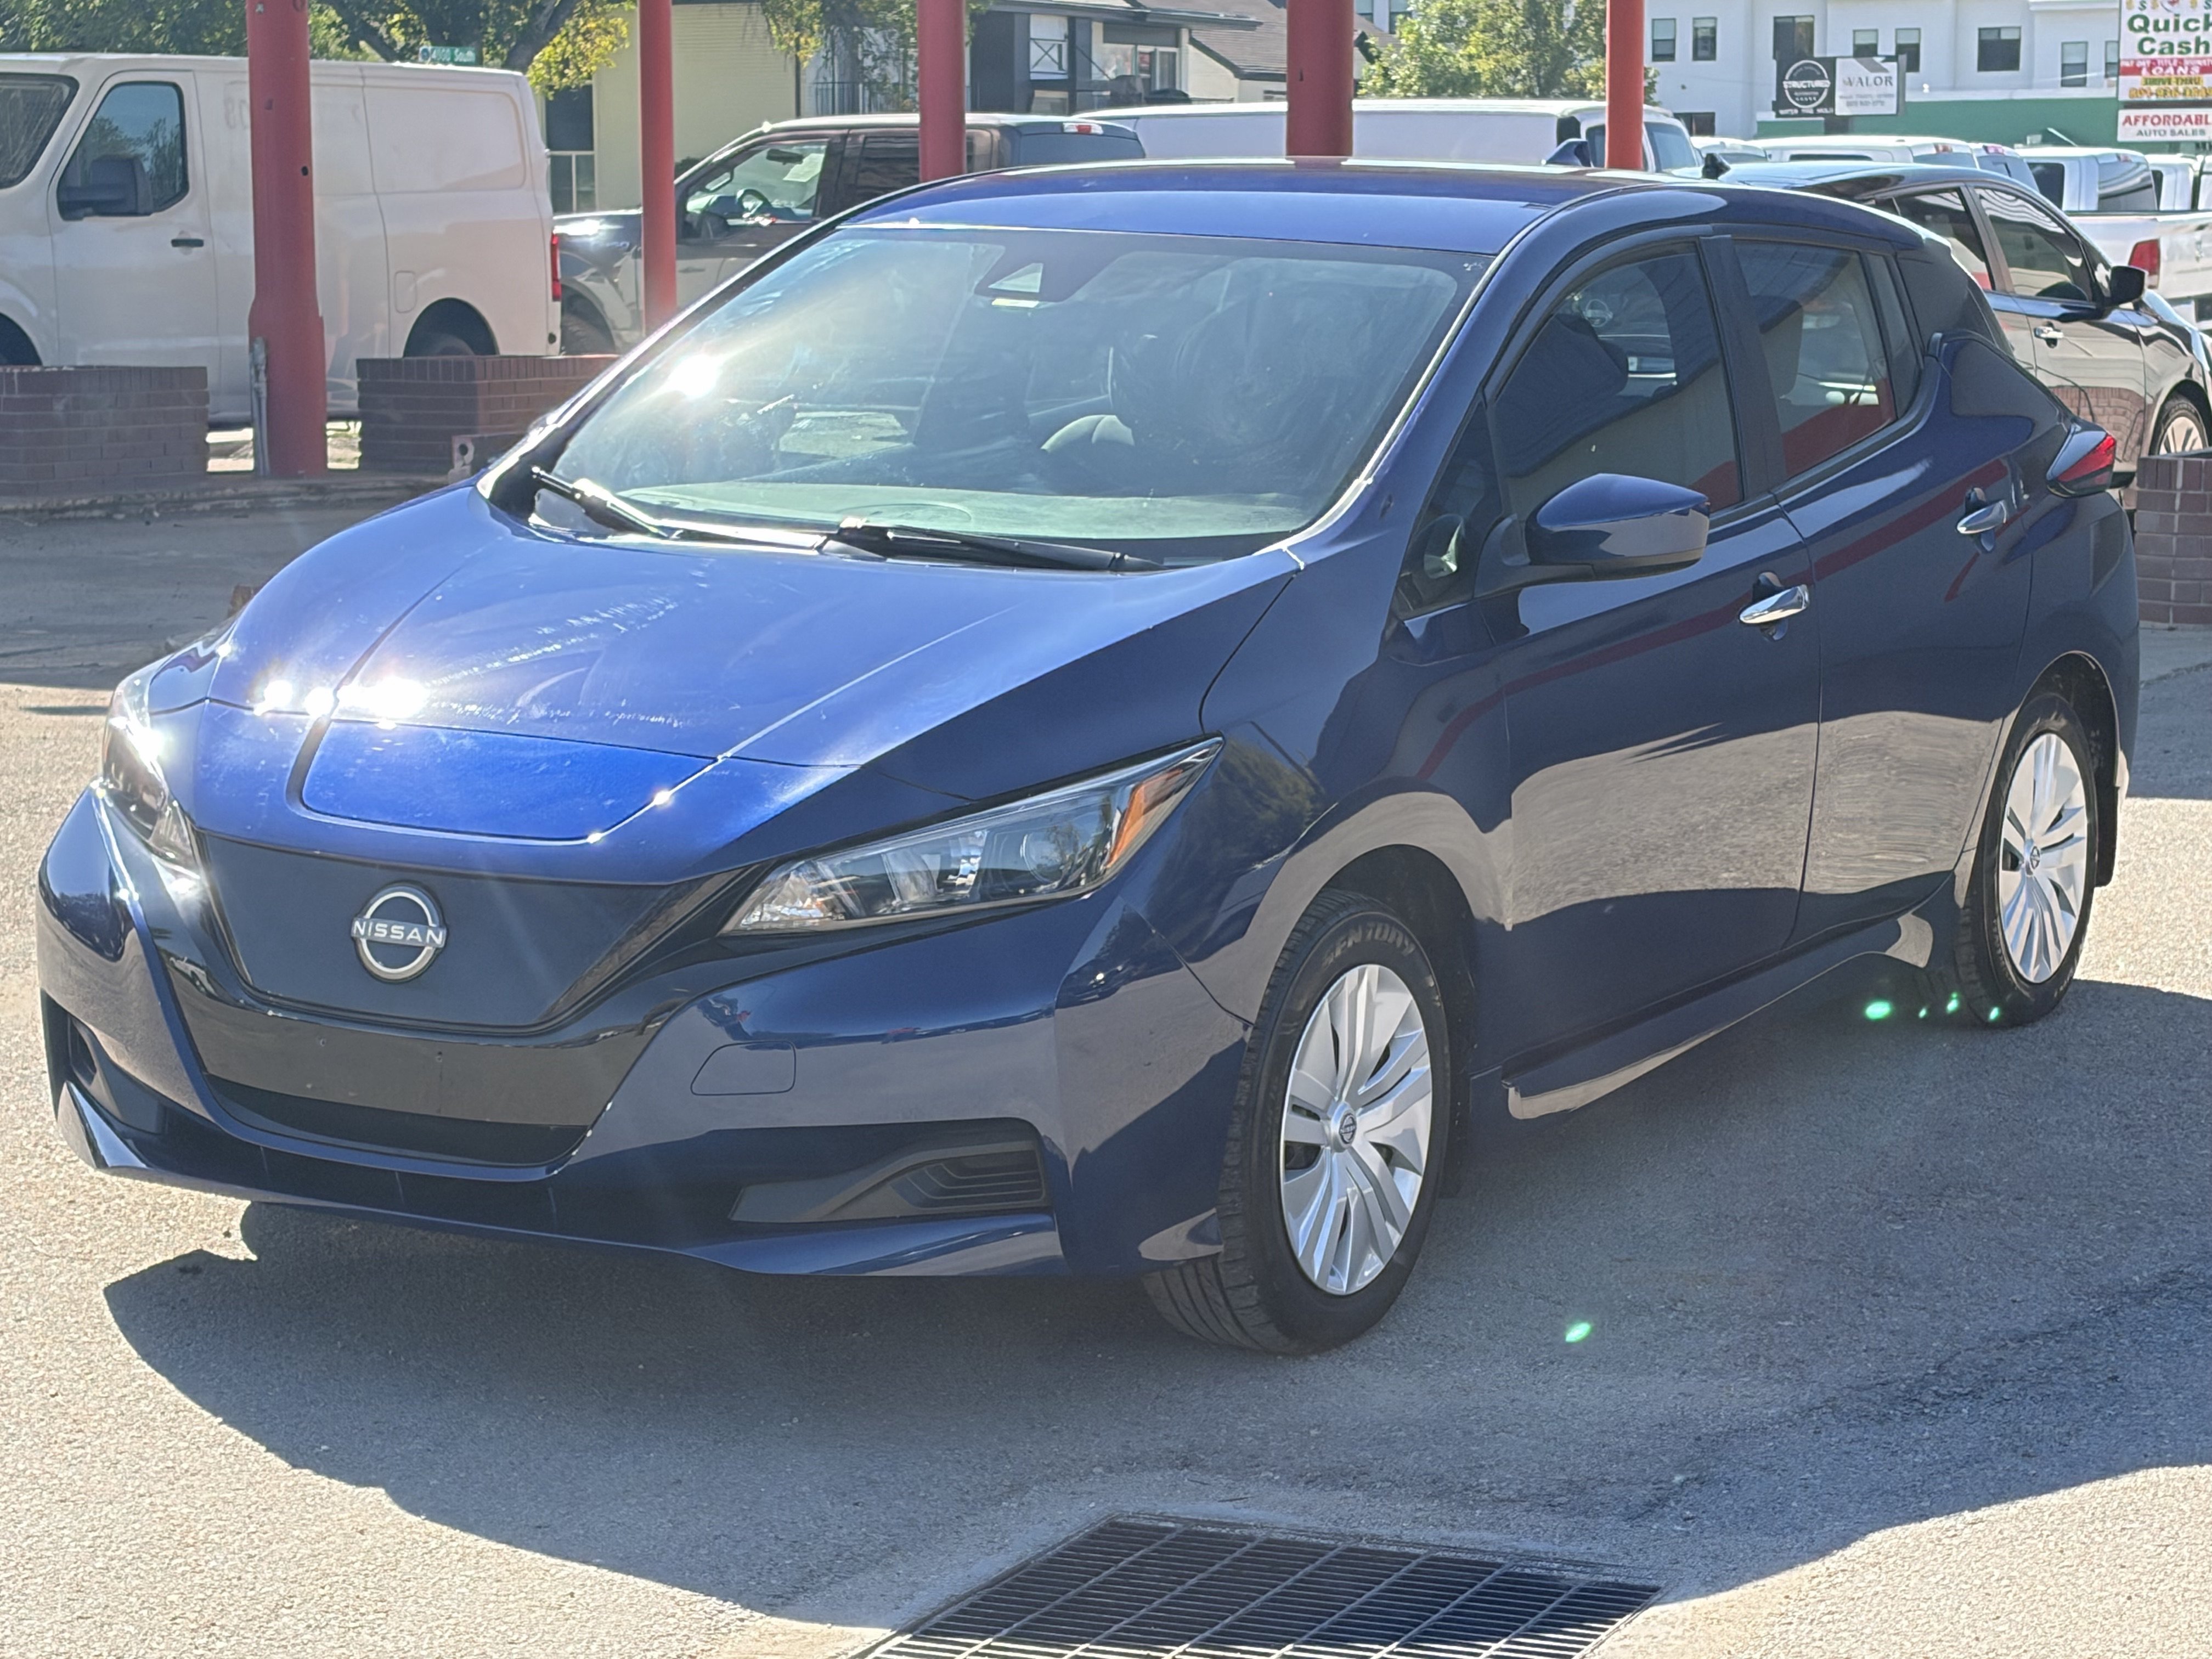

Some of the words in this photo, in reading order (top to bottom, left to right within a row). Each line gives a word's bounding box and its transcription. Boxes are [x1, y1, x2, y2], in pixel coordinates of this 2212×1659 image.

[2137, 36, 2210, 55] Cash
[2141, 66, 2200, 75] LOANS
[1843, 76, 1893, 87] VALOR
[353, 920, 443, 945] NISSAN
